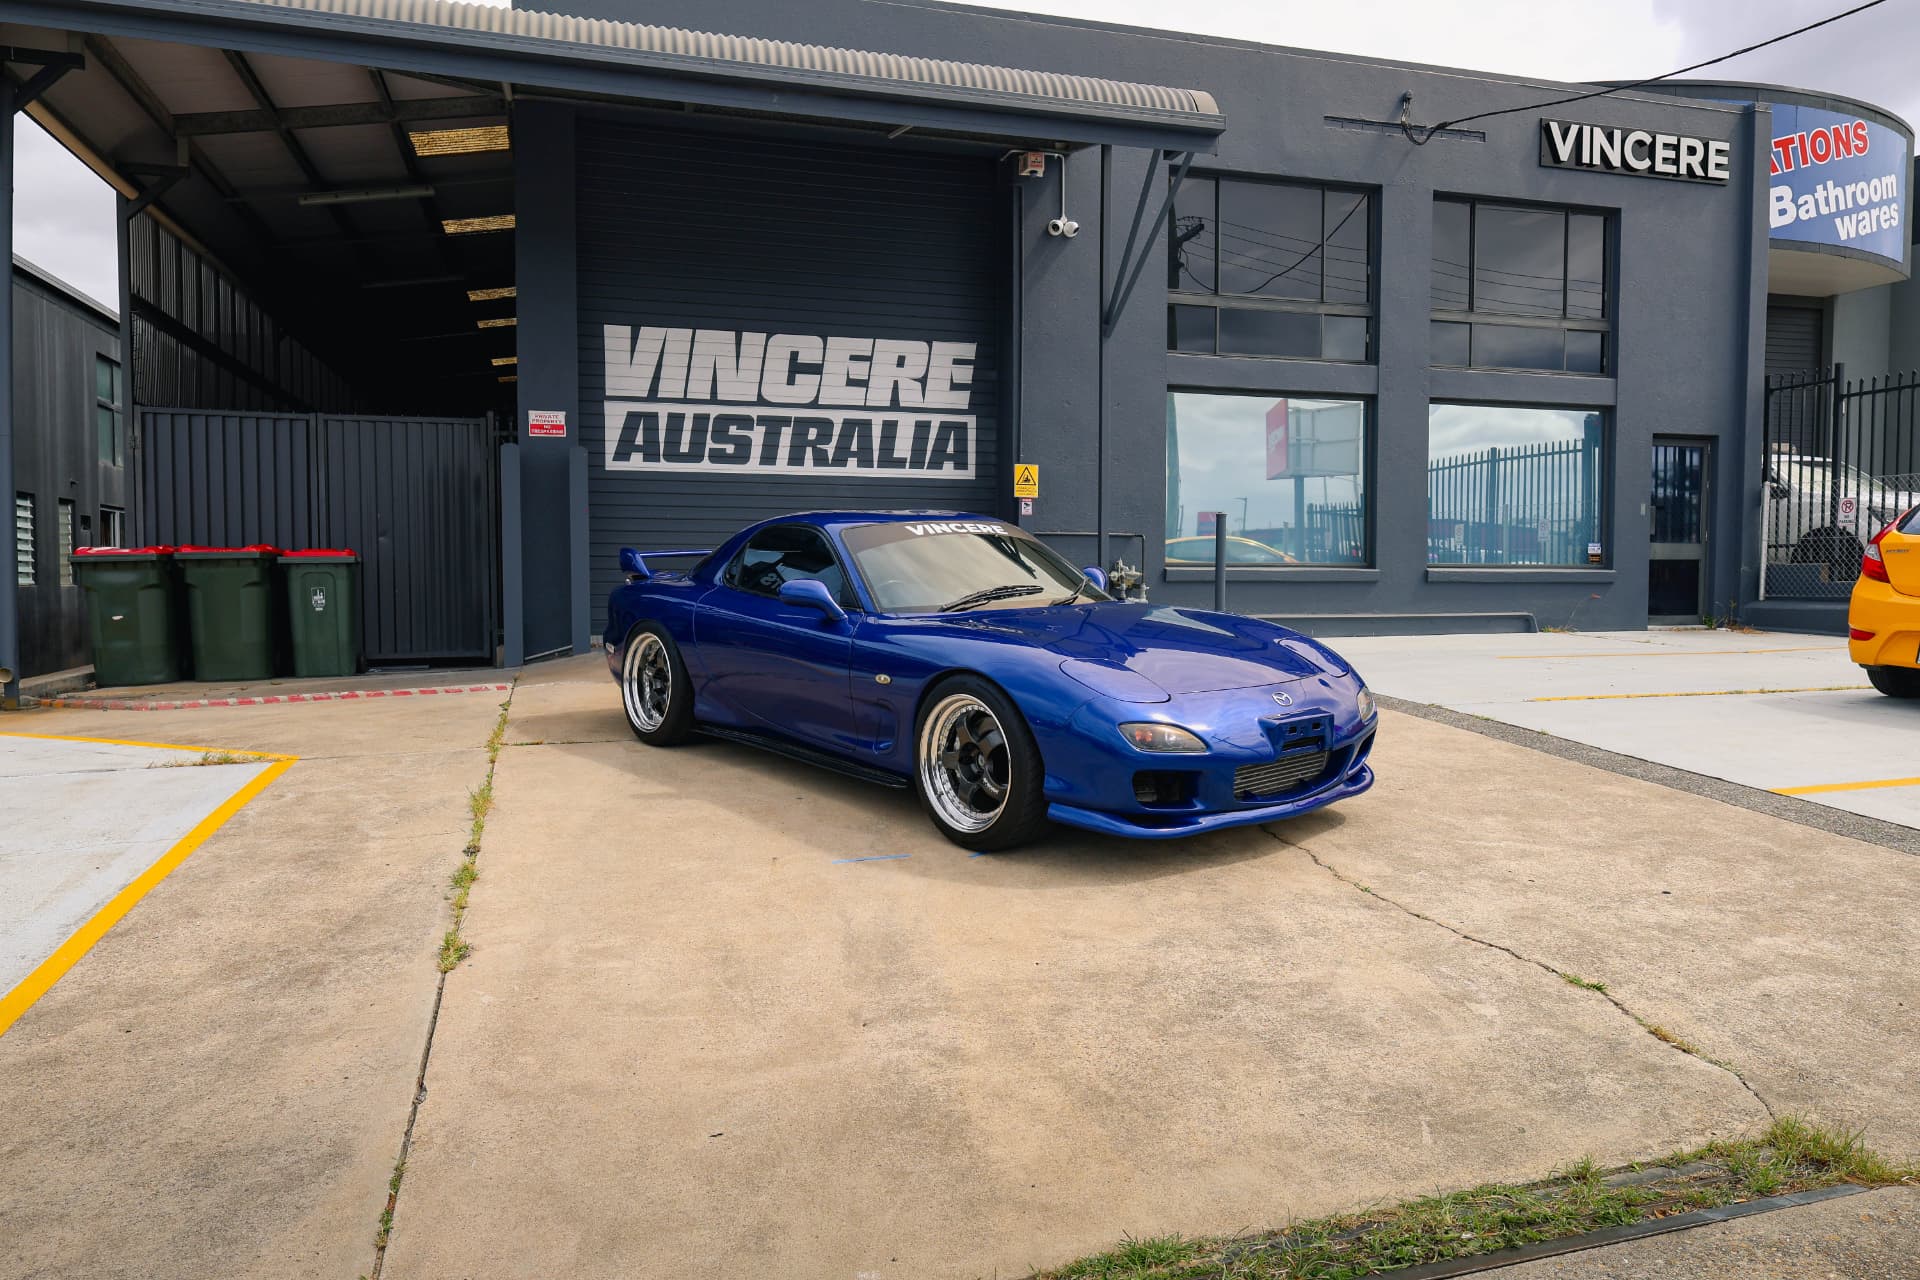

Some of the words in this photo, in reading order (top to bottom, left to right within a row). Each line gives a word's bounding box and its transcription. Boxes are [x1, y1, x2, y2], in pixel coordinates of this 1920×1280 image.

[1549, 121, 1730, 180] VINCERE
[1770, 174, 1897, 229] Bathroom
[1835, 203, 1899, 241] wares
[603, 324, 977, 409] VINCERE
[612, 411, 969, 471] AUSTRALIA
[904, 523, 1008, 536] VINCERE
